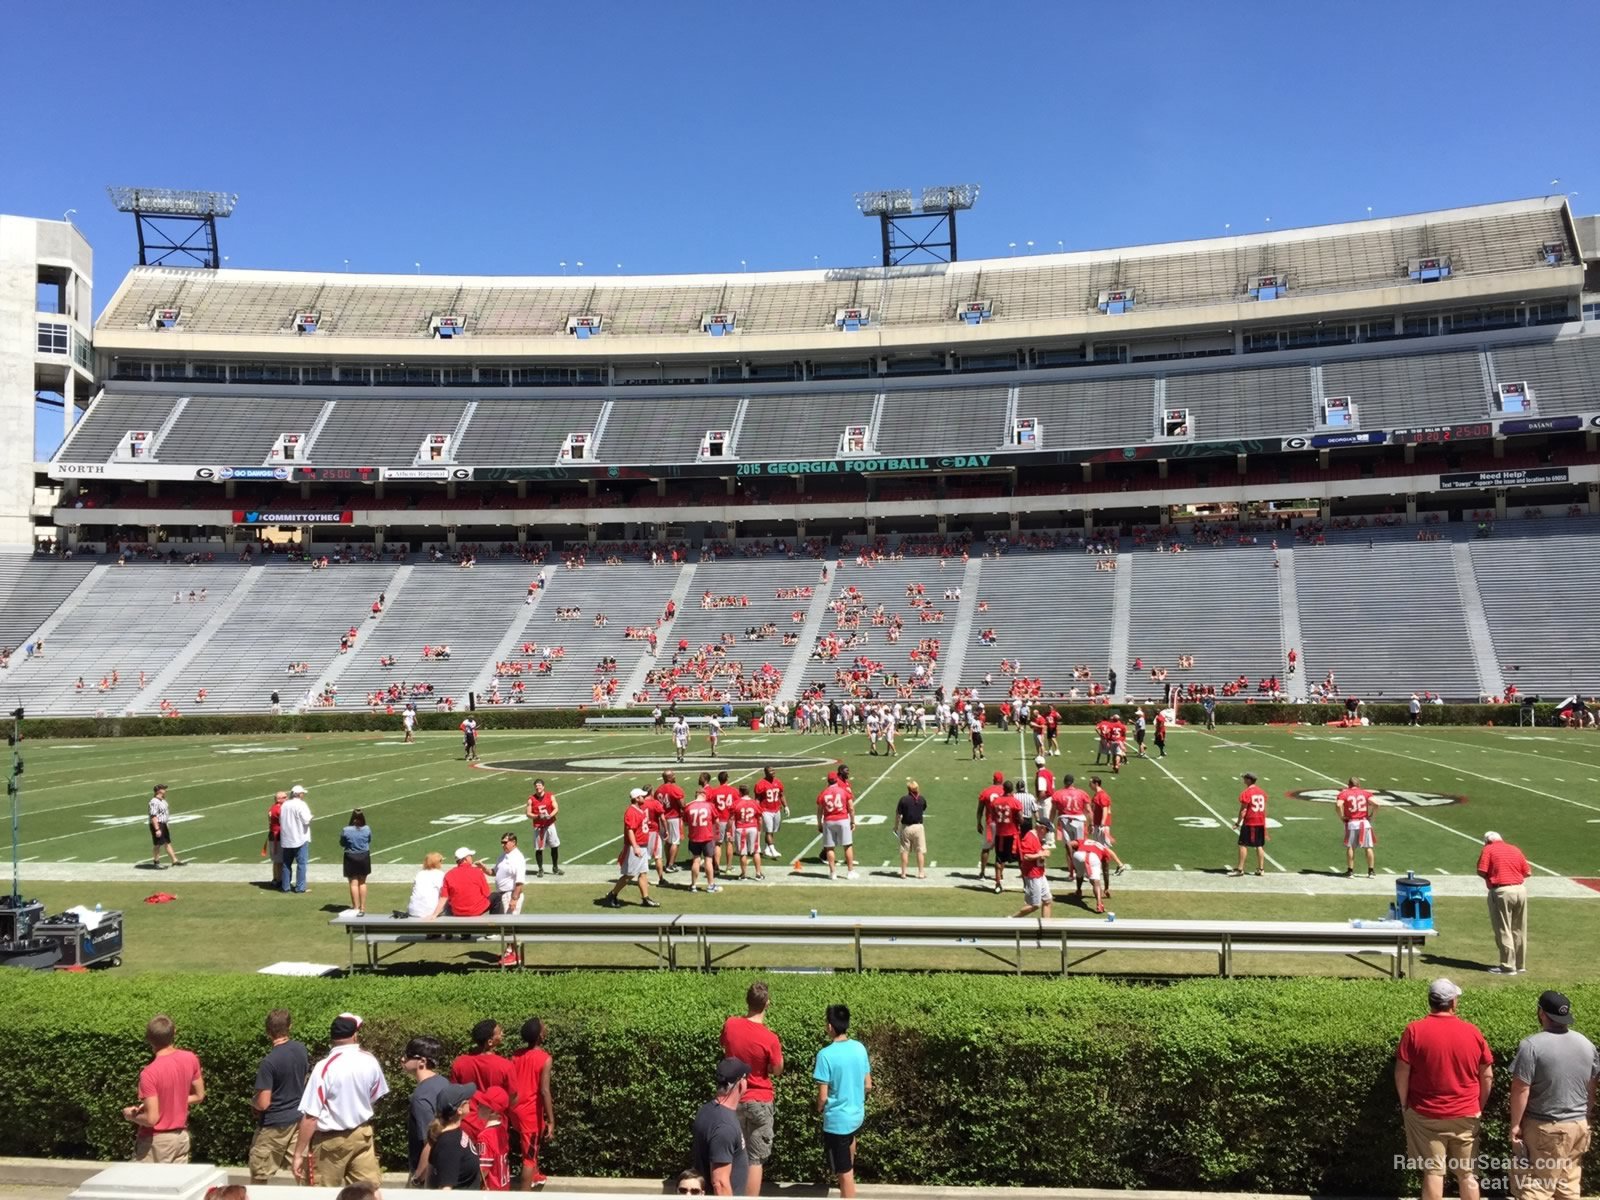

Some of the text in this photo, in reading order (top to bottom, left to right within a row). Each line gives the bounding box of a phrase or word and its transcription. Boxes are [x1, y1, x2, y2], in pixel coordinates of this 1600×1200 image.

[1529, 422, 1553, 430] DASANI
[1443, 432, 1450, 440] 2
[58, 465, 105, 474] NORTH
[737, 463, 761, 475] 2015
[767, 461, 839, 474] GEORGIA
[845, 458, 929, 472] FOOTBALL
[418, 471, 445, 479] Regional
[1503, 471, 1527, 479] Help?
[258, 514, 340, 522] #COMMITTOTHEG
[716, 793, 733, 811] 54
[765, 787, 780, 803] 97
[823, 793, 843, 813] 54
[1250, 795, 1265, 812] 59
[1346, 795, 1367, 812] 32
[689, 807, 709, 827] 72
[740, 807, 755, 823] 12
